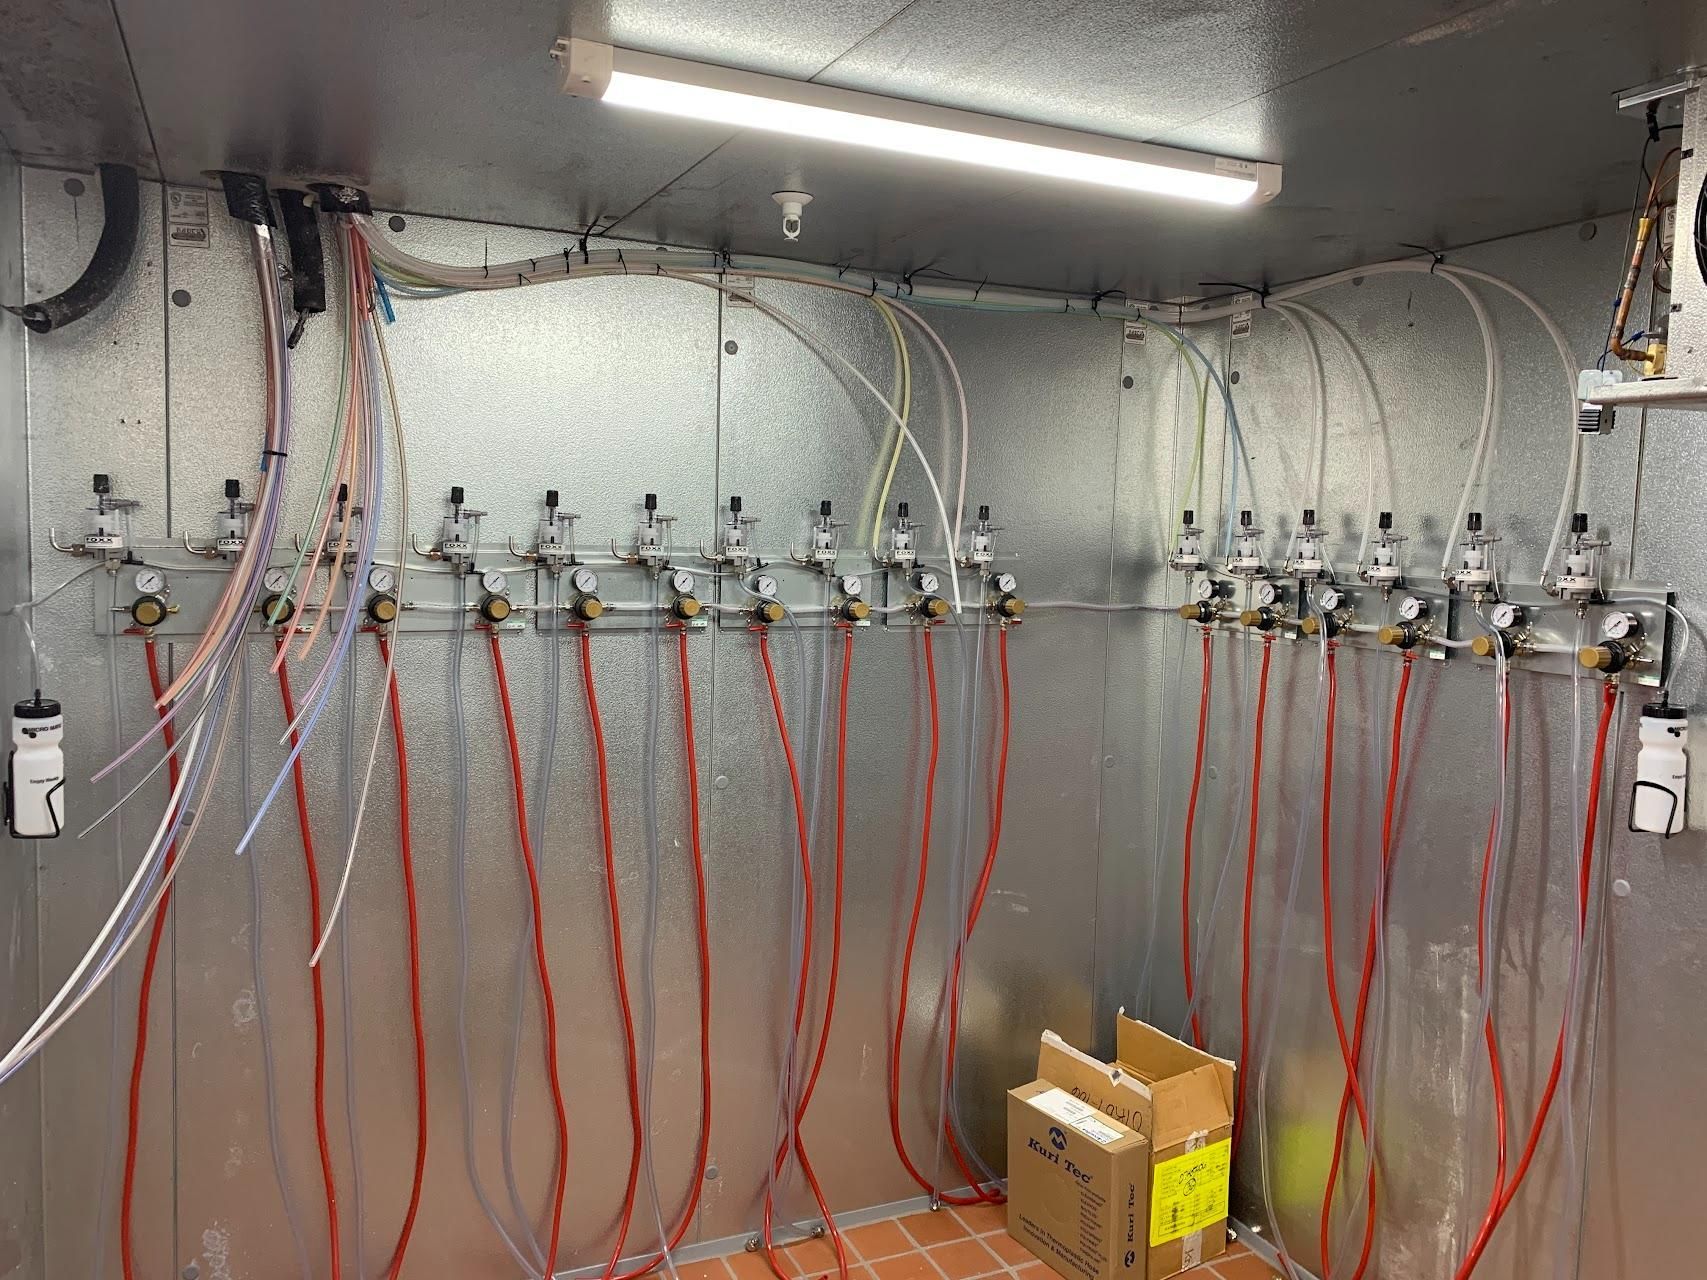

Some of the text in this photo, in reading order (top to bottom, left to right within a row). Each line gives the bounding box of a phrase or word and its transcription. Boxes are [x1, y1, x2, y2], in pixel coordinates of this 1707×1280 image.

[1028, 1136, 1091, 1184] Kuri Tec
[1019, 1213, 1099, 1275] Leaders in Thermoplastic Hose
